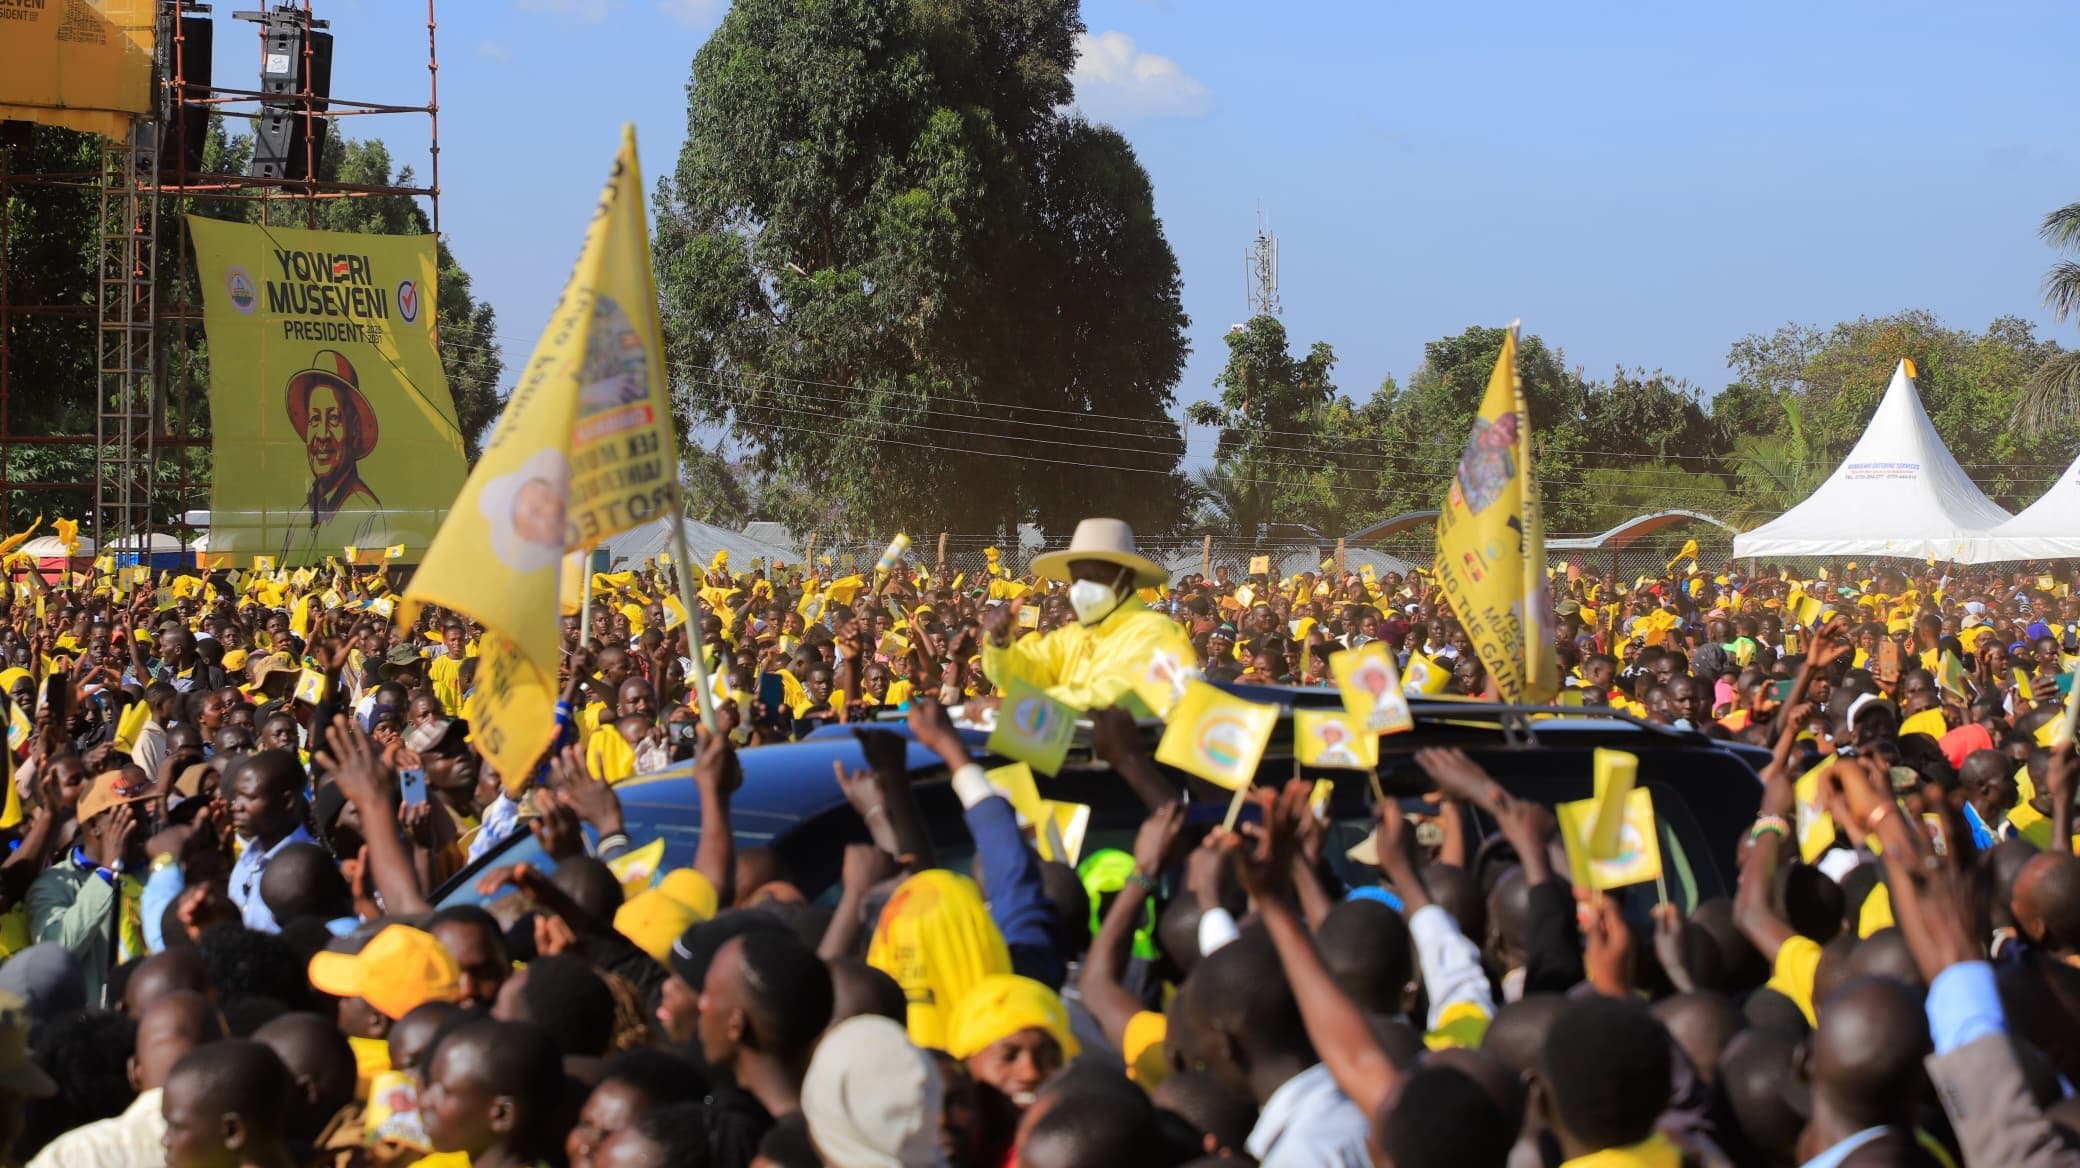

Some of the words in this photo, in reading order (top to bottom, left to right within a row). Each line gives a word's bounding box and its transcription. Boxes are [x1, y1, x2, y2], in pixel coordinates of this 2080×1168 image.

[273, 250, 373, 286] YOWERI
[267, 281, 390, 319] MUSEVENI
[283, 320, 365, 342] PRESIDENT
[1458, 595, 1485, 640] THE
[1481, 642, 1521, 700] GAIN
